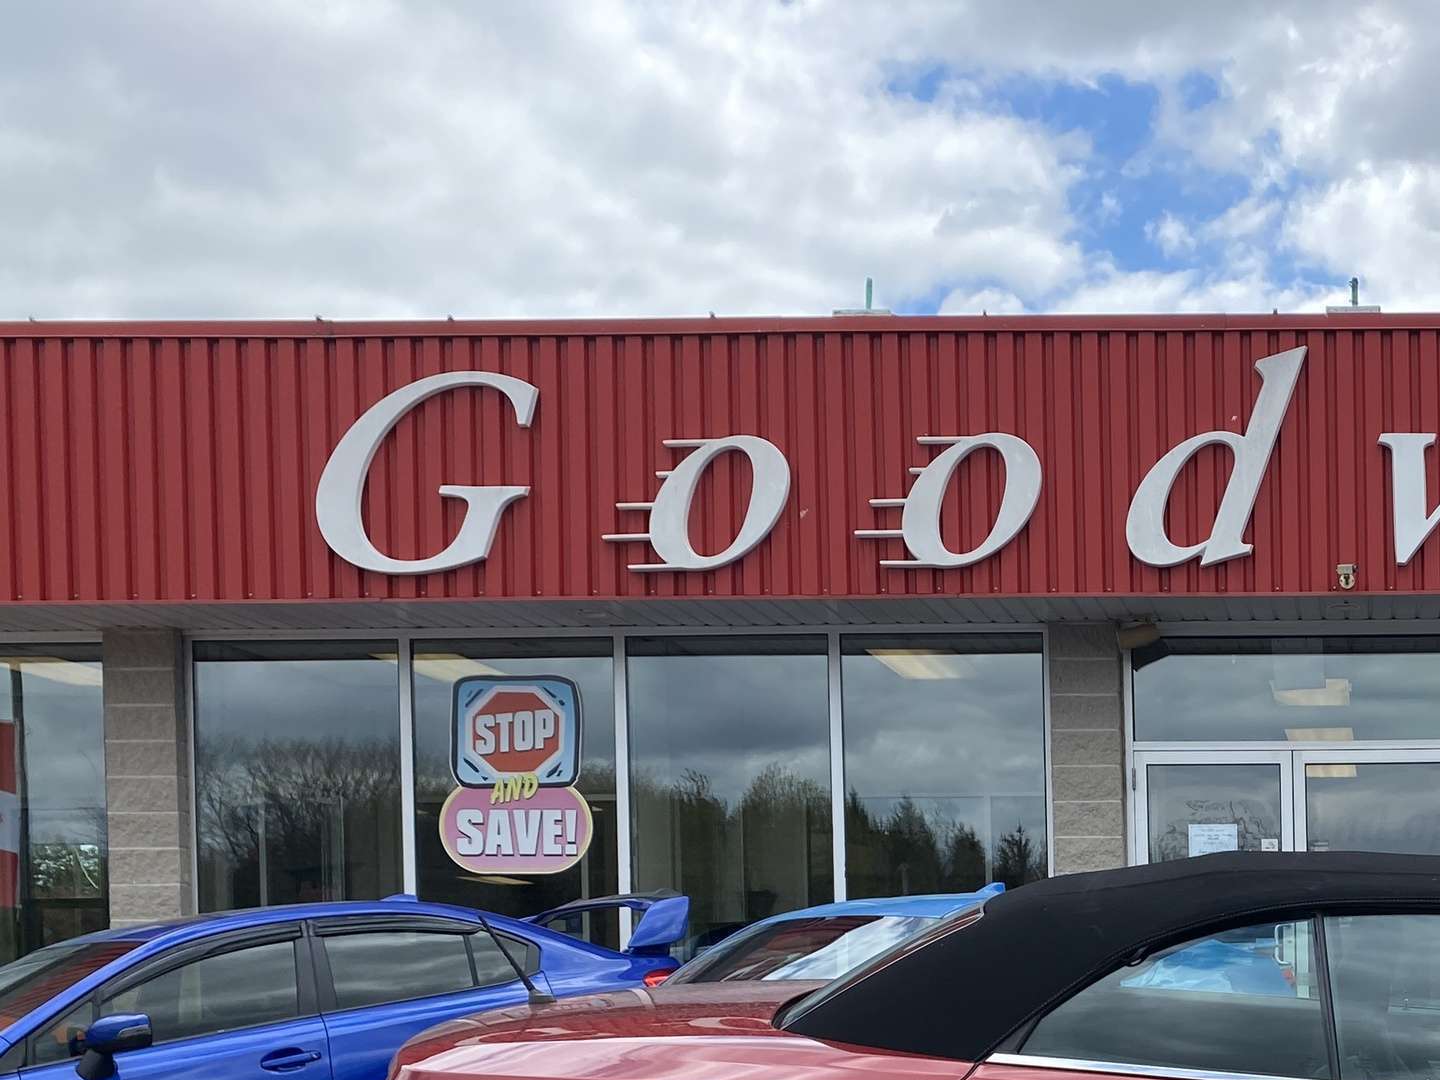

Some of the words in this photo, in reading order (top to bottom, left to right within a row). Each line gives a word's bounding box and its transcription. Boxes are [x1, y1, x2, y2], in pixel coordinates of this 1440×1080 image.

[475, 709, 555, 756] STOP
[490, 772, 540, 805] AND
[456, 809, 578, 857] SAVE!
